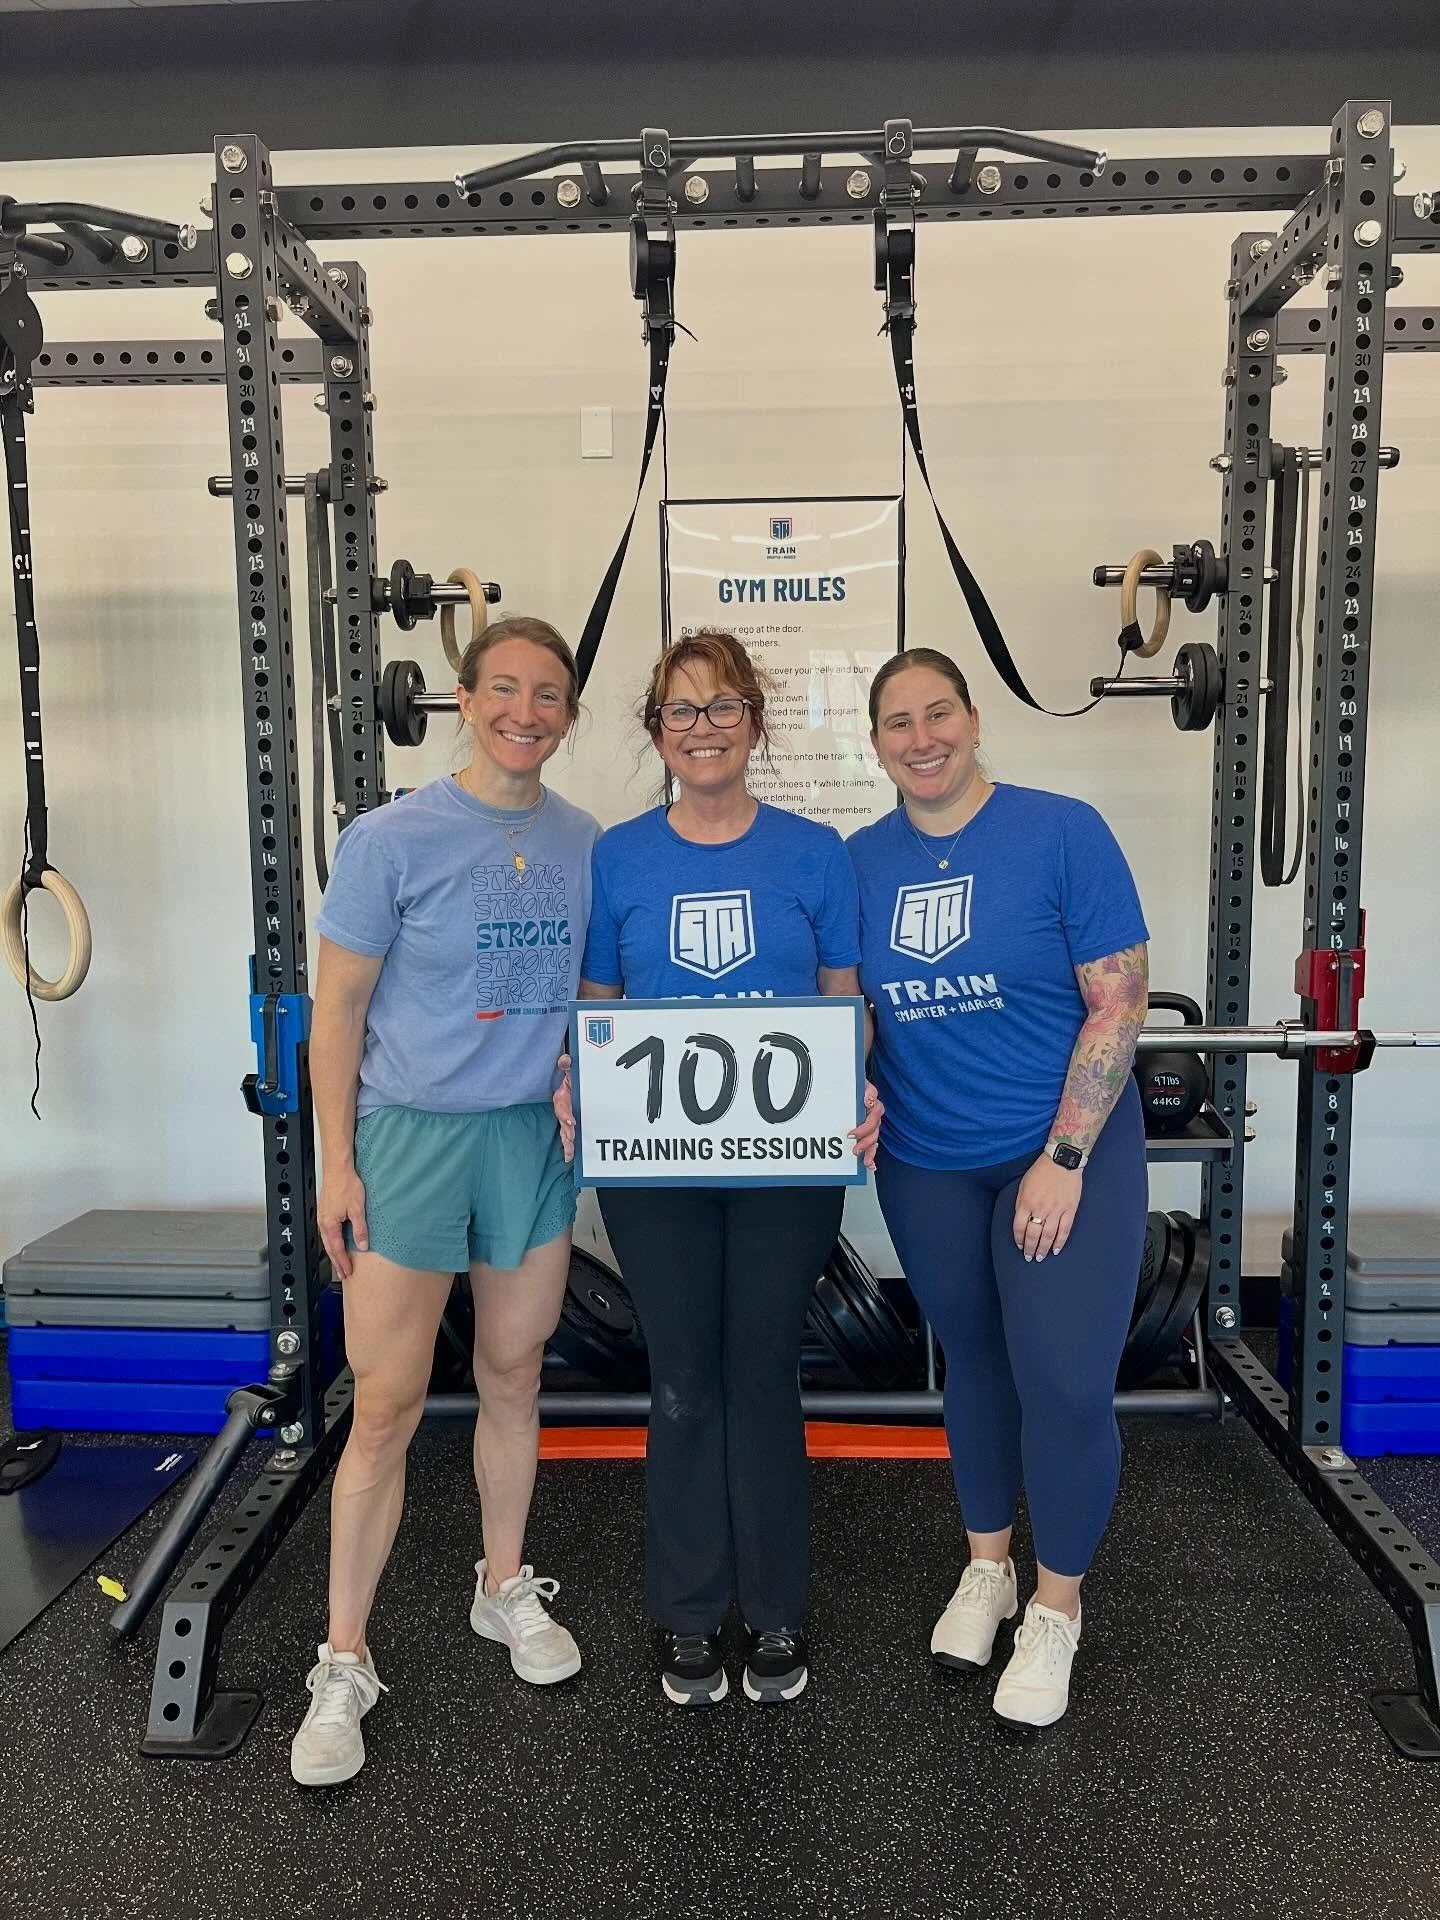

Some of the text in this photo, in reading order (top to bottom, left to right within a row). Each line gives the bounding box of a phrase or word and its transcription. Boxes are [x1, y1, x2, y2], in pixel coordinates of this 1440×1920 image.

[1358, 280, 1374, 294] 32
[234, 313, 251, 328] 32
[1356, 316, 1370, 332] 31
[236, 348, 250, 362] 31
[1354, 354, 1371, 366] 30
[239, 384, 255, 398] 30
[1353, 386, 1371, 404] 29
[240, 418, 255, 433] 29
[1352, 423, 1368, 440] 28
[242, 452, 259, 468] 28
[1350, 460, 1366, 474] 27
[244, 488, 260, 500] 27
[1350, 495, 1366, 510] 26
[246, 522, 264, 537] 26
[1346, 528, 1363, 545] 25
[766, 546, 796, 554] TRAIN
[248, 554, 264, 570] 25
[1346, 566, 1361, 578] 24
[250, 590, 265, 602] 24
[718, 576, 846, 604] GYM RULES
[1344, 598, 1360, 614] 23
[251, 621, 266, 637] 23
[681, 626, 693, 634] Do
[738, 626, 754, 636] ego
[756, 626, 764, 634] at
[766, 625, 780, 633] the
[782, 624, 804, 633] door.
[1342, 634, 1360, 650] 22
[252, 656, 270, 671] 22
[769, 667, 793, 675] cover
[794, 667, 812, 678] your
[1340, 670, 1355, 682] 21
[255, 690, 268, 702] 21
[1340, 702, 1357, 716] 20
[256, 722, 272, 736] 20
[1338, 735, 1352, 750] 19
[258, 754, 272, 770] 19
[815, 752, 829, 760] the
[748, 780, 766, 788] shirt
[778, 780, 805, 788] shoes
[819, 780, 841, 788] while
[842, 779, 877, 788] training.
[770, 794, 807, 804] clothing.
[798, 806, 808, 815] of
[808, 806, 830, 815] other
[832, 806, 872, 815] members
[1337, 802, 1350, 818] 17
[262, 820, 274, 834] 17
[1335, 836, 1348, 850] 16
[262, 852, 277, 866] 16
[471, 864, 566, 892] STRONG
[1334, 870, 1348, 882] 15
[264, 886, 280, 898] 15
[474, 892, 569, 922] STRONG
[1332, 902, 1346, 916] 14
[266, 916, 280, 930] 14
[476, 920, 572, 950] STRONG
[1330, 934, 1343, 949] 13
[267, 948, 281, 962] 13
[476, 948, 570, 980] STRONG
[269, 981, 284, 992] 12
[476, 975, 568, 1008] STRONG
[881, 974, 998, 1006] TRAIN
[894, 1005, 948, 1023] SMARTER
[616, 1032, 814, 1126] 100
[1152, 1097, 1181, 1106] 44KG
[1328, 1094, 1338, 1110] 8
[1326, 1126, 1336, 1141] 7
[276, 1136, 288, 1150] 7
[596, 1136, 843, 1161] TRAINING SESSIONS
[1324, 1190, 1334, 1204] 5
[281, 1198, 290, 1211] 5
[1322, 1220, 1334, 1234] 4
[281, 1227, 292, 1242] 4
[284, 1288, 294, 1301] 2
[1320, 1284, 1331, 1296] 2
